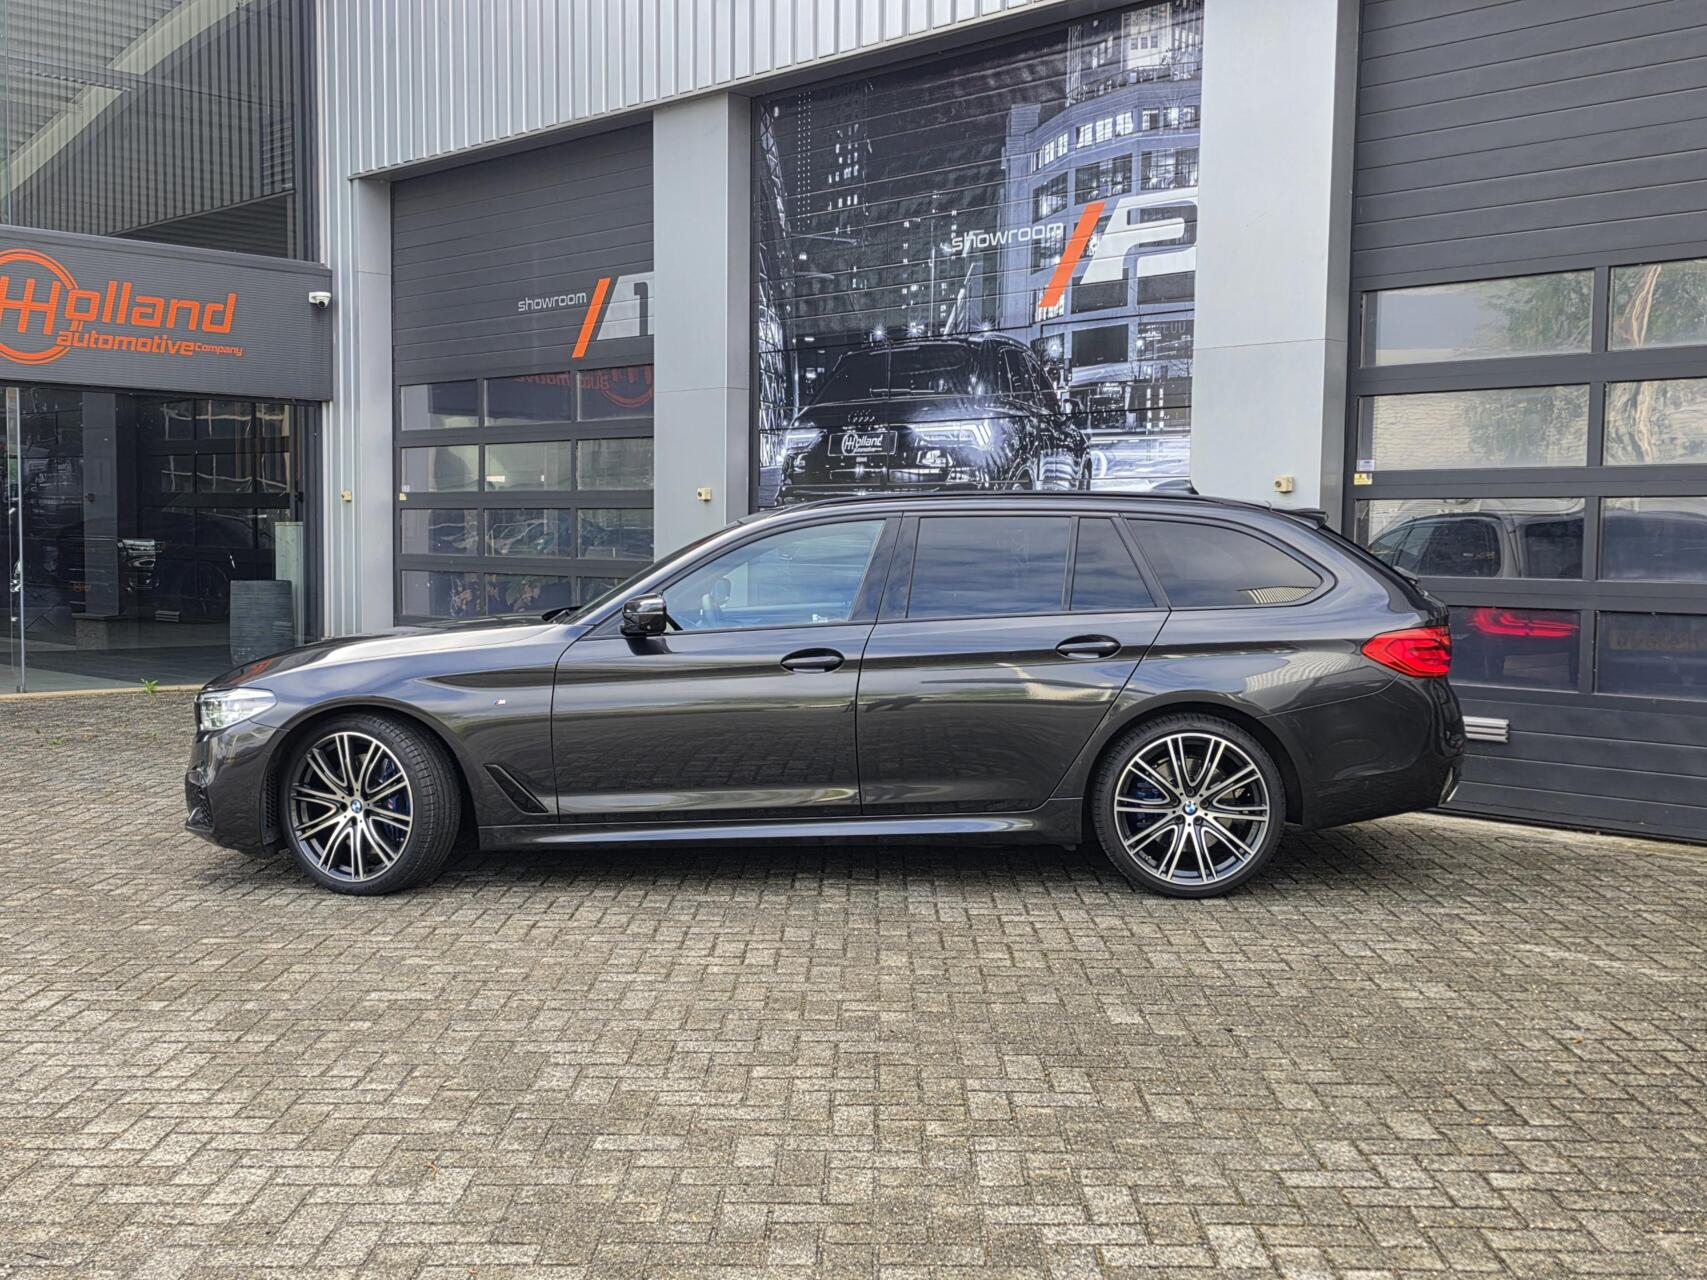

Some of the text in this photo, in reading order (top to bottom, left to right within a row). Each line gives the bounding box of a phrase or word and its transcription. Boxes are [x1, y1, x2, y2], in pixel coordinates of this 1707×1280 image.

[951, 222, 1064, 252] showroom
[517, 291, 587, 312] showroom
[56, 330, 195, 356] automotive
